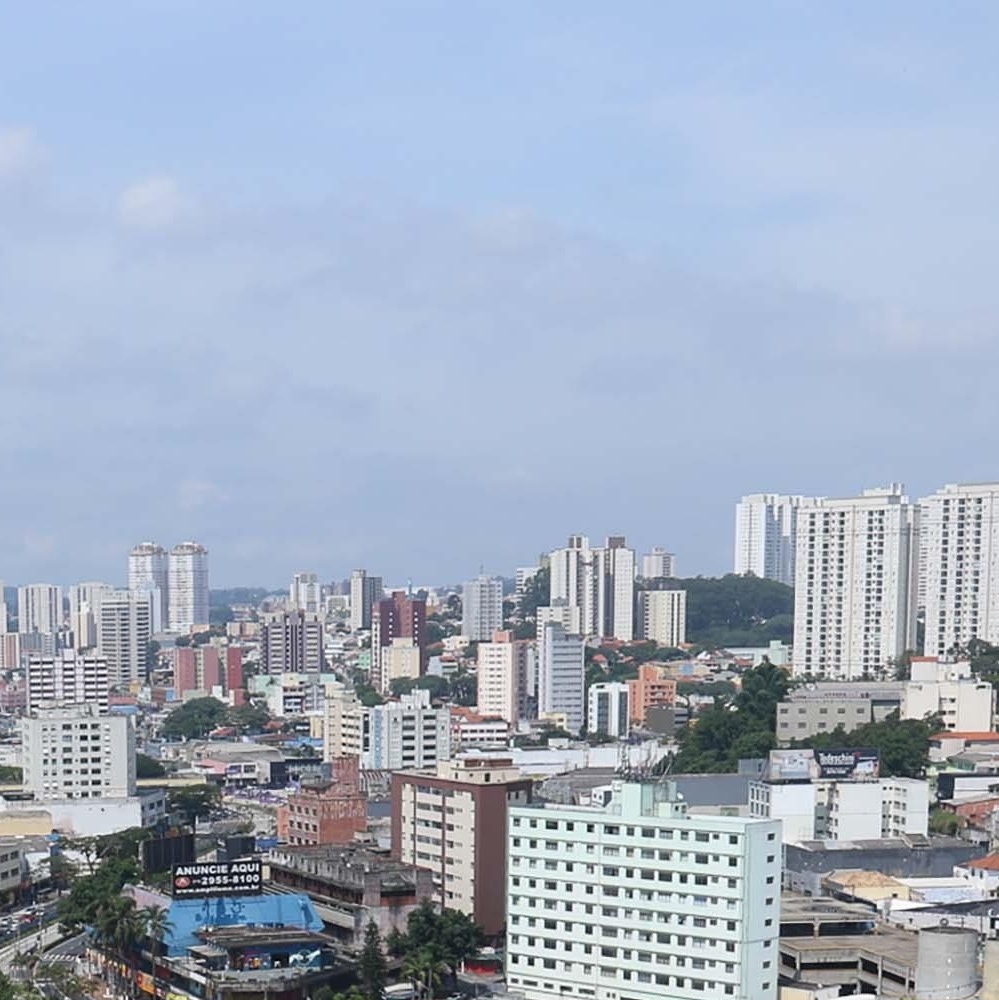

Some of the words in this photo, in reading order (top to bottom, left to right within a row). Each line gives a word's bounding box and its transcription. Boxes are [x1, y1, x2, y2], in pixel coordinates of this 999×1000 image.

[176, 865, 228, 876] ANUNCIE
[231, 863, 259, 873] AQUI
[201, 875, 259, 885] 2955-8100
